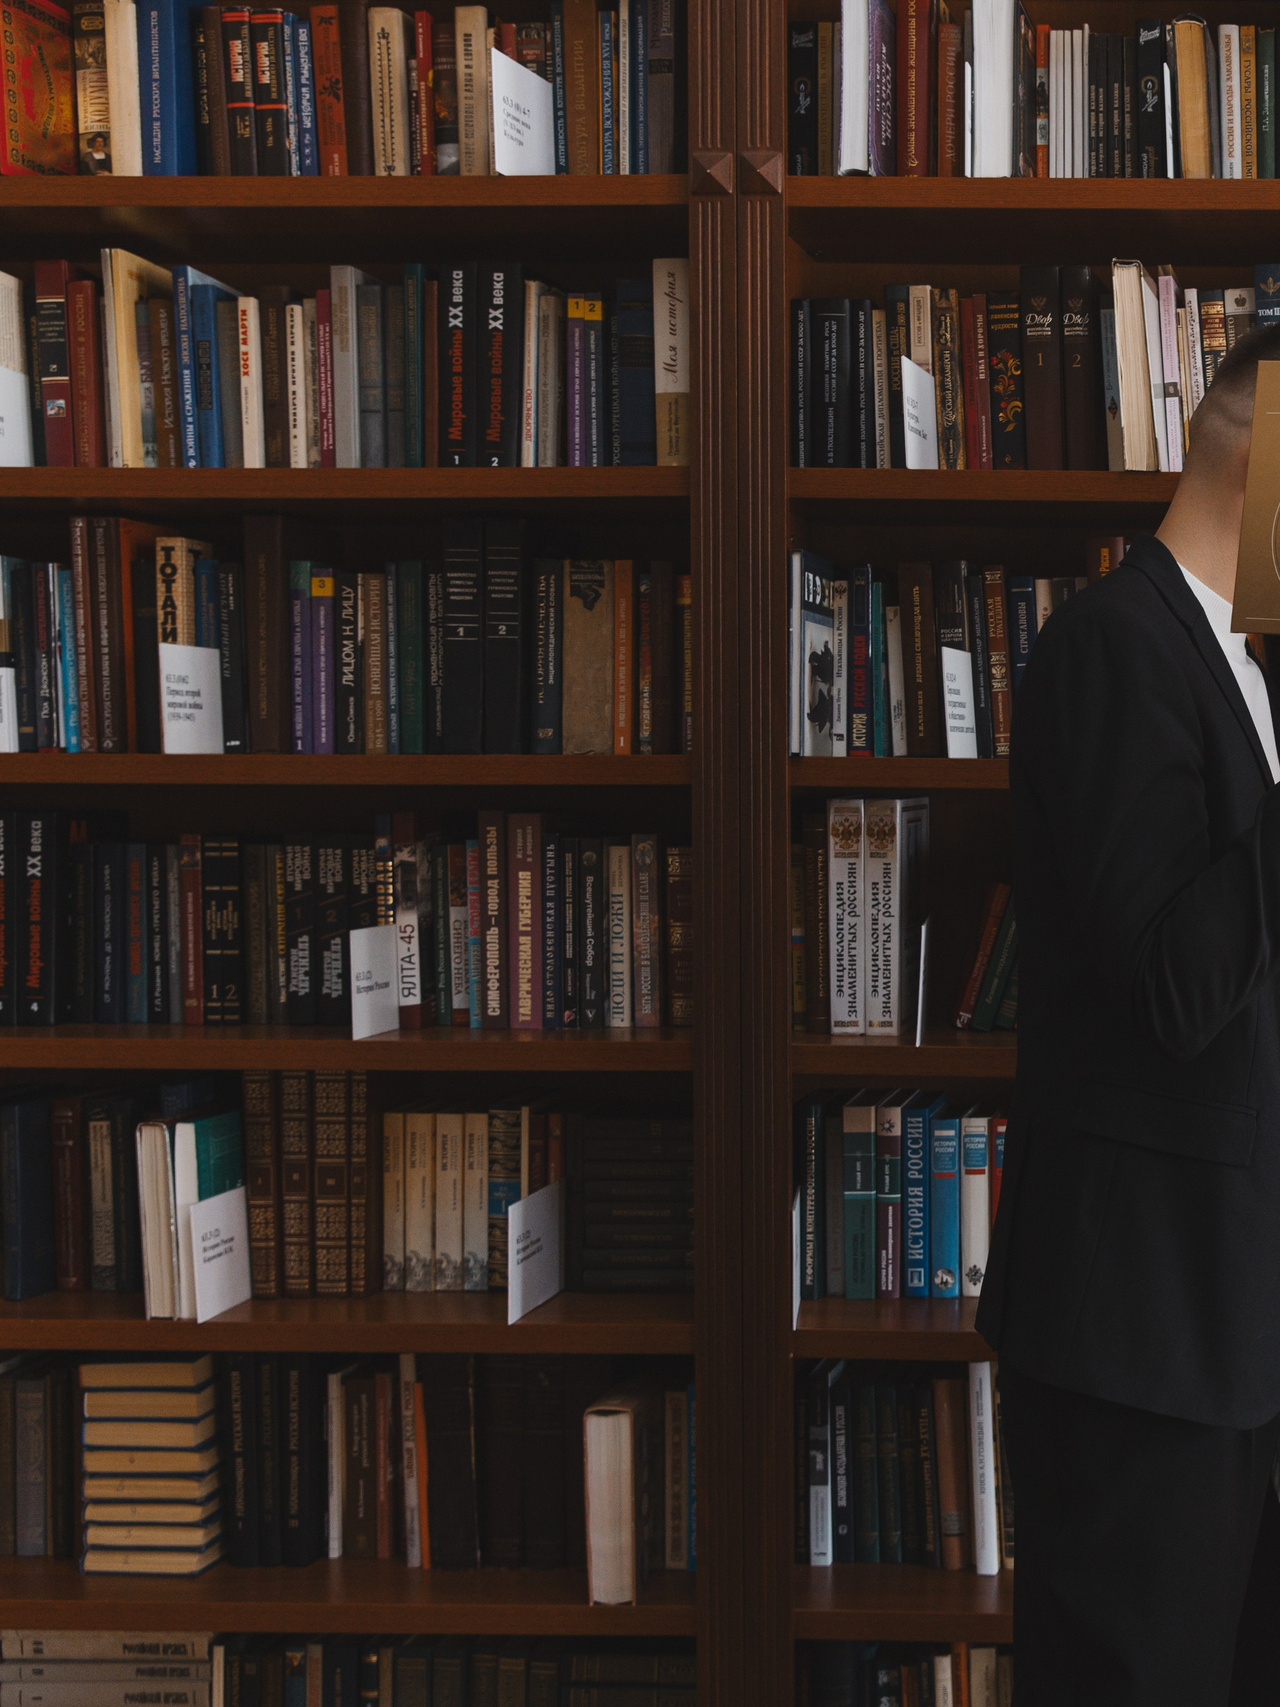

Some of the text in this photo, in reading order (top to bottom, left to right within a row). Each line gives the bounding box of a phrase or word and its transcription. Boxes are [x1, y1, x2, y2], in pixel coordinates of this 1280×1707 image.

[229, 40, 243, 81] ИСТОРИЯ
[256, 42, 270, 83] ИСТОРИЯ
[907, 18, 916, 129] ЗНАМЕНИТЫЕ ЖЕНЩИНЫ
[945, 46, 956, 161] ДОЧЕРИ РОССИИ
[1224, 34, 1232, 82] ЗАКАВКАЗЬЯ
[1226, 85, 1234, 116] НАРОДЫ
[574, 40, 588, 176] КУЛЬТУРА ВИЗАНТИИ
[603, 60, 613, 174] КУЛЬТУРА ВОЗРОЖДЕНИЯ
[1244, 60, 1253, 156] ГУСАРЫ РОССИЙСКОЙ
[240, 309, 248, 346] МАРТИ
[448, 270, 466, 440] Мировые войны XX века
[486, 272, 505, 442] Мировые войны XX века
[662, 272, 683, 383] Моя история
[1036, 353, 1043, 366] 1
[1072, 353, 1081, 367] 2
[1258, 308, 1273, 316] ТОМ
[178, 277, 196, 456] ВОЙНЫ СРАЖЕНИЯ ЭПОХИ НАПОЛЕОНА
[342, 586, 355, 687] ЛИЦОМ ЛИЦУ
[369, 580, 381, 695] НОВЕЙШАЯ ИСТОРИЯ
[995, 596, 1004, 638] ТРАГЕДИЯ
[1018, 602, 1028, 654] СТРОГАНОВЫ
[853, 636, 867, 746] ИСТОРИЯ РУССКОЙ ВОДКИ
[25, 820, 44, 988] Мировые войны XX века
[286, 846, 294, 882] ВТОРАЯ
[294, 846, 302, 891] МИРОВАЯ
[302, 846, 311, 879] ВОЙНА
[298, 935, 309, 996] ЧЕРЧИЛЛЬ
[399, 924, 416, 998] ЯЛТА-45
[486, 826, 500, 1016] СИМФЕРОПОЛЬ ГОРОД ПОЛЬЗЫ
[518, 871, 532, 1022] ТАВРИЧЕСКАЯ ГУБЕРНИЯ
[584, 876, 594, 966] Всешутейший Собор
[611, 894, 625, 1022] ЛЮДИ И ЛОЖИ
[836, 882, 846, 998] ЭНЦИКЛОПЕДИЯ
[871, 882, 881, 998] ЭНЦИКЛОПЕДИЯ
[848, 923, 857, 1019] ЗНАМЕНИТЫХ
[882, 923, 892, 1019] ЗНАМЕНИТЫХ
[907, 1117, 923, 1259] ИСТОРИЯ РОССИИ
